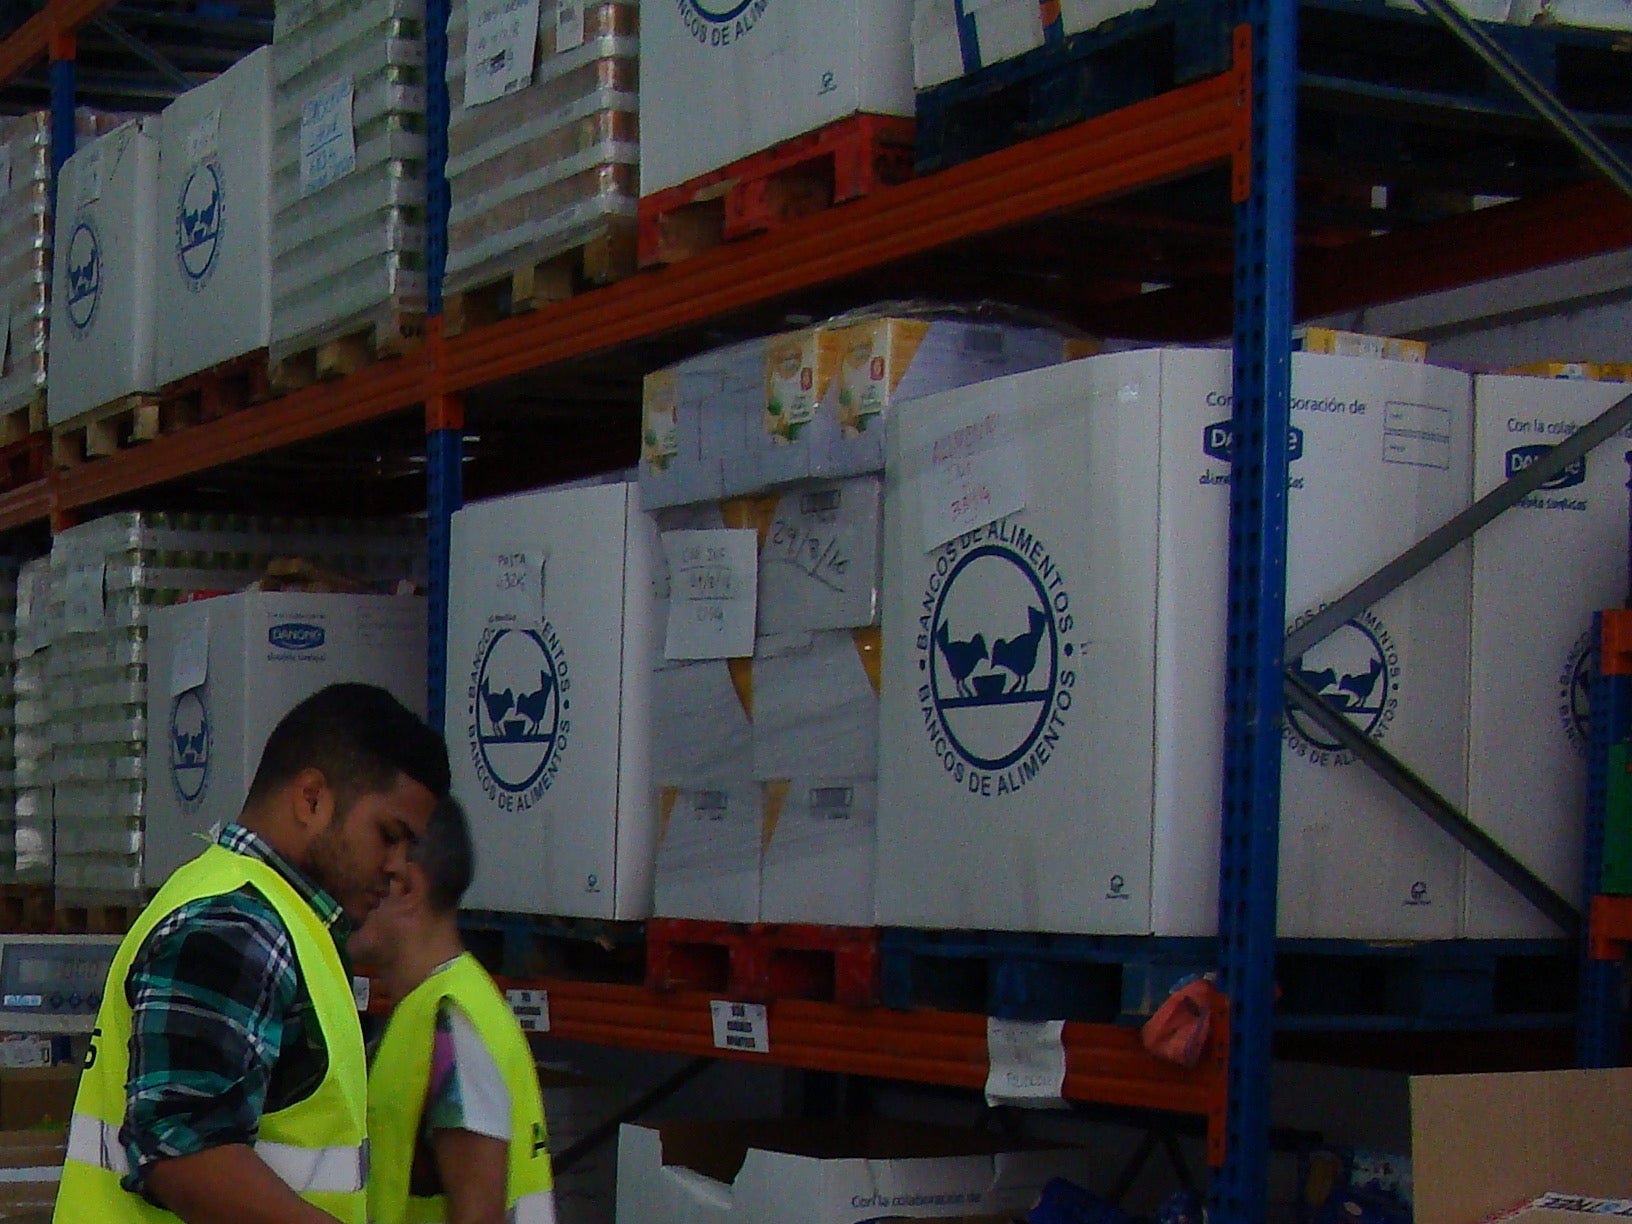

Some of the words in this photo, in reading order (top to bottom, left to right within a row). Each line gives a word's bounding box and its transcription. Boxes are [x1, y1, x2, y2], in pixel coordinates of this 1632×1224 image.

[918, 542, 958, 651] BANCOS
[988, 520, 1074, 634] ALIMENTOS
[498, 792, 514, 813] DE
[516, 719, 571, 814] ALIMENTOS
[918, 684, 964, 784] BANCOS
[968, 771, 991, 797] DE
[997, 669, 1076, 797] ALIMENTOS
